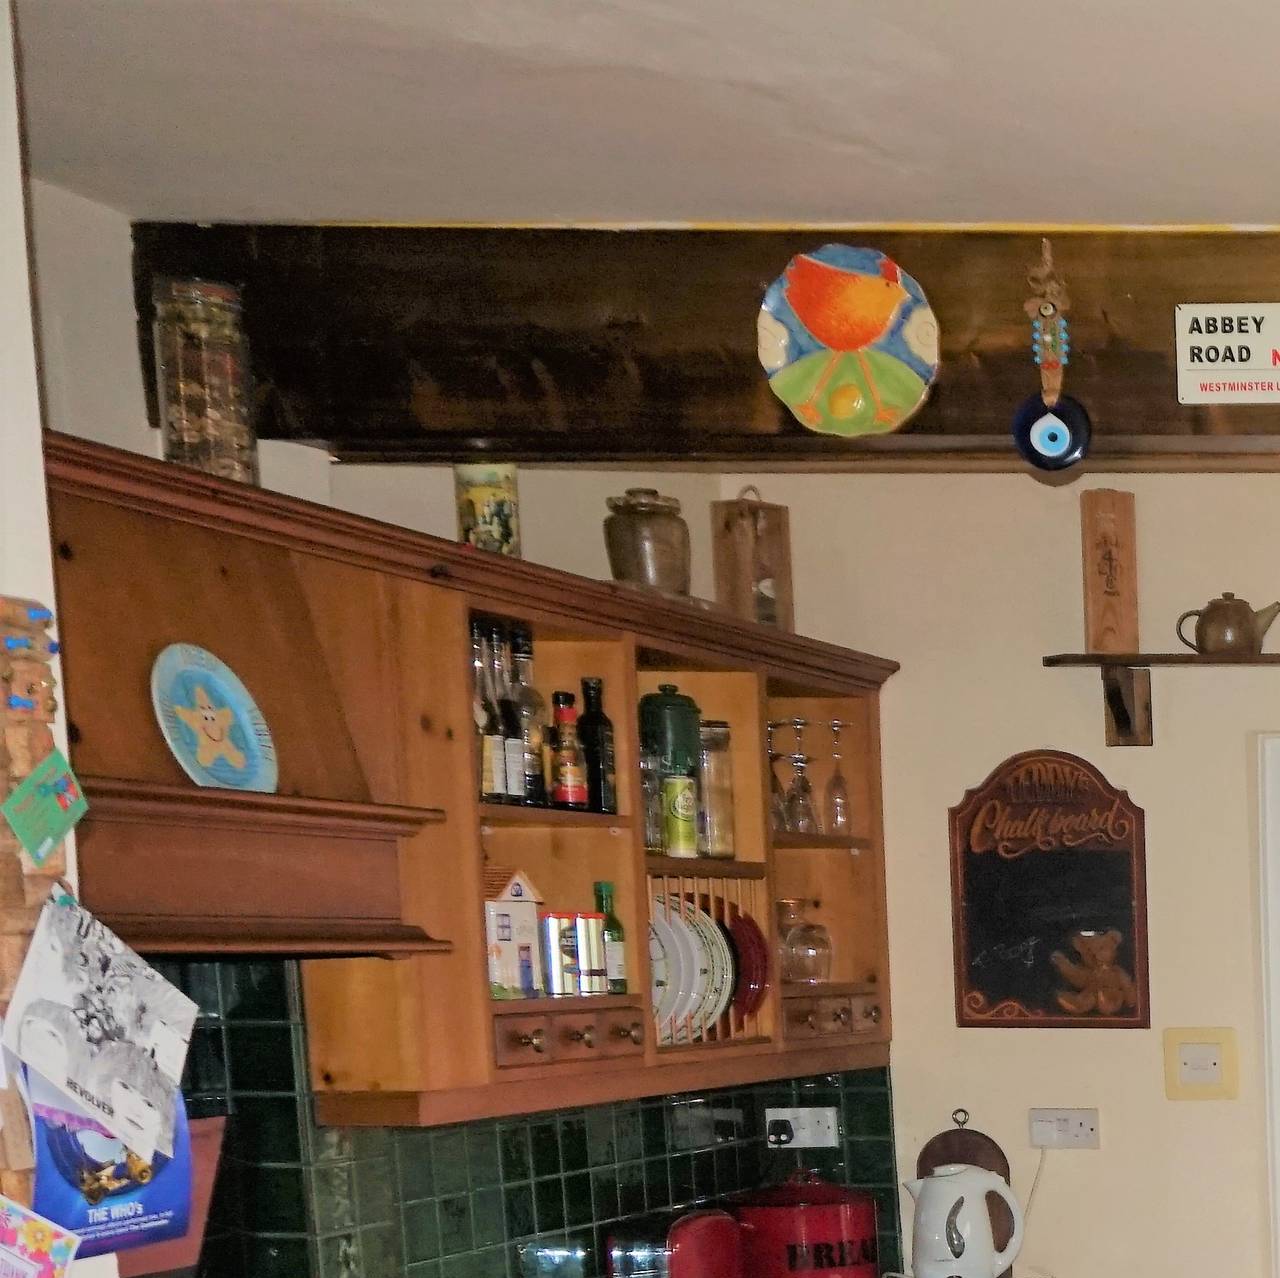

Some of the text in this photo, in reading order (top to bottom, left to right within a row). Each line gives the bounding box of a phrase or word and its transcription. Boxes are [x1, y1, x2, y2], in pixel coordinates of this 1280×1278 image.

[1188, 315, 1265, 335] ABBEY
[1189, 345, 1251, 363] ROAD
[1199, 381, 1274, 393] WESTMINSTER
[66, 1077, 115, 1117] REVOLVER
[87, 1207, 109, 1225] THE
[785, 1238, 878, 1271] BREA
